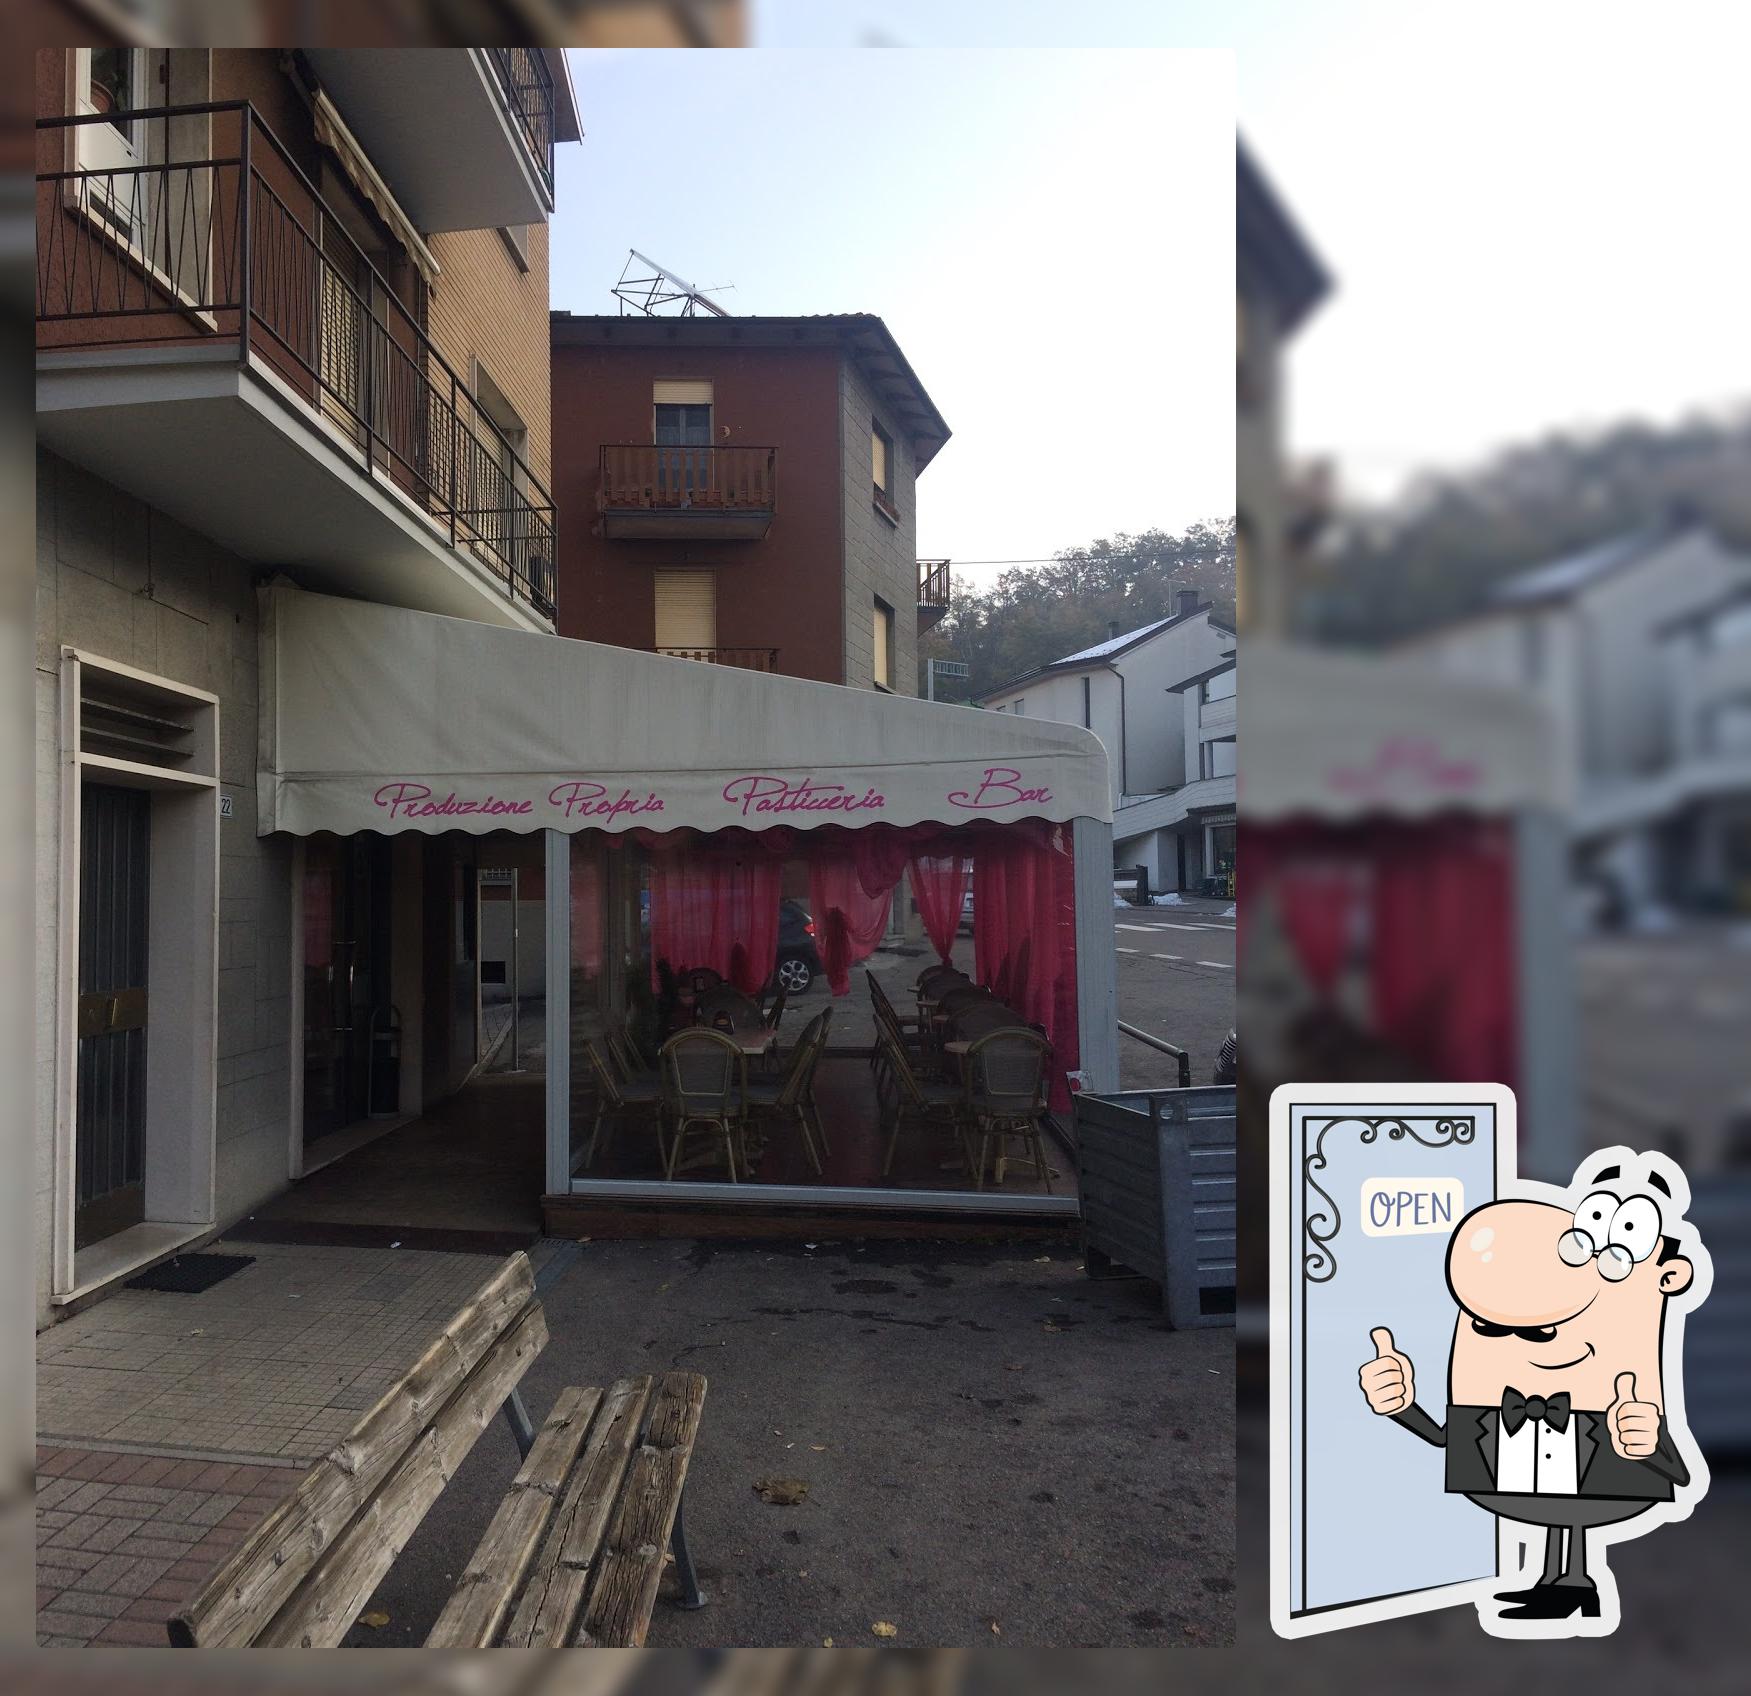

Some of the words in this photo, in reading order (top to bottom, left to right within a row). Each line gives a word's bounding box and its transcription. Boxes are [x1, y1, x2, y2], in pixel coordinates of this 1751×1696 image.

[221, 798, 231, 814] 22
[374, 783, 533, 819] Produzione
[548, 782, 665, 824] Propria
[723, 776, 885, 816] Pasticceria
[947, 767, 1053, 809] Bar
